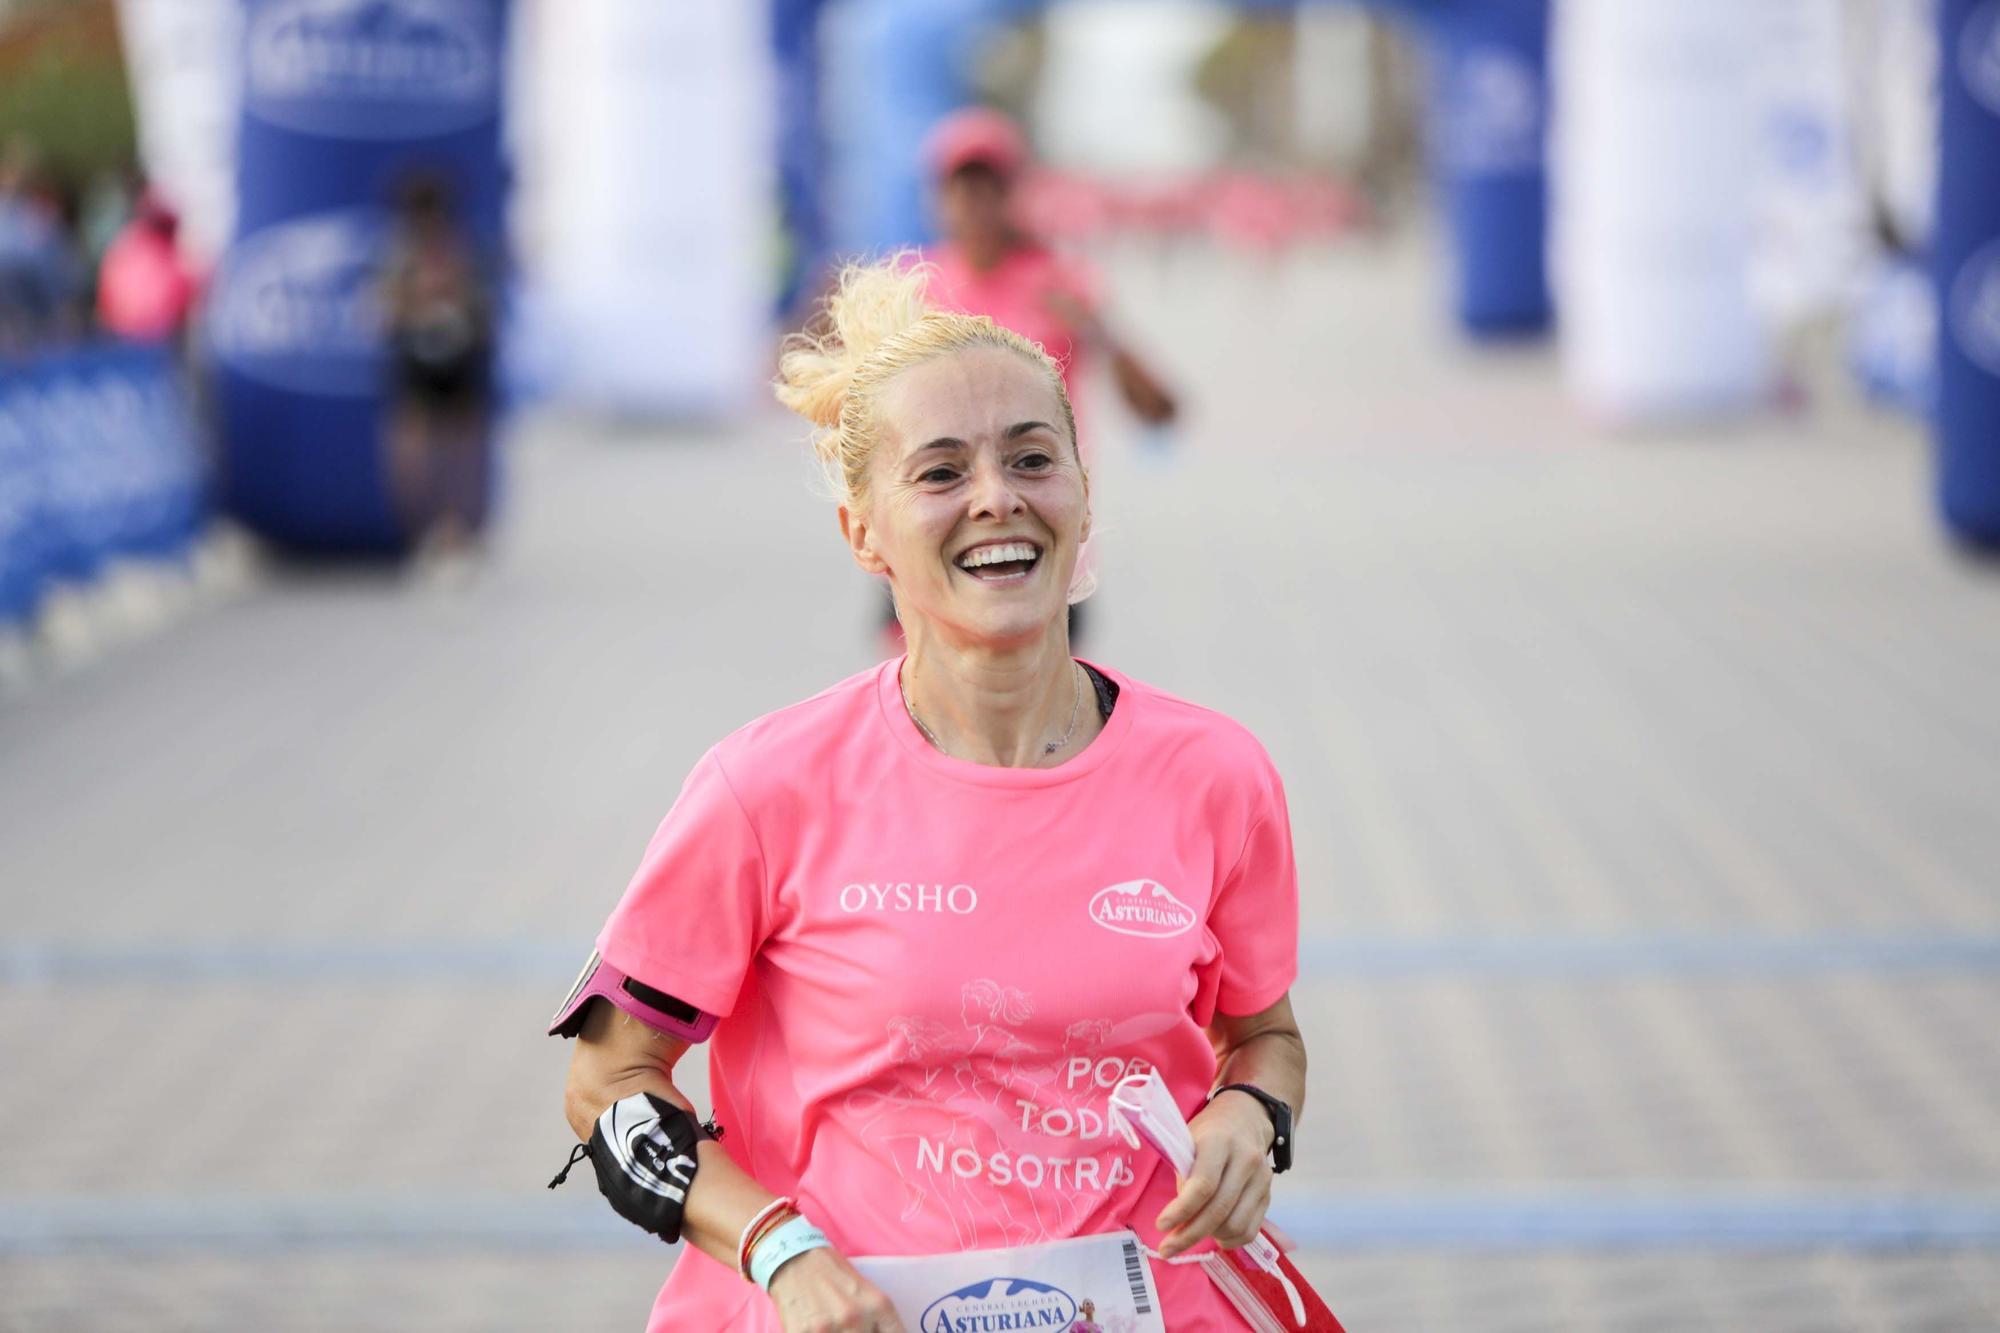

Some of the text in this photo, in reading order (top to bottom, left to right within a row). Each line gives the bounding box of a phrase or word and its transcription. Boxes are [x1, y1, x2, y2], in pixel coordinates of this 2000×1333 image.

[839, 882, 978, 915] OYSHO
[1098, 896, 1190, 926] ASTURIANA
[935, 1306, 1067, 1333] ASTURIANA
